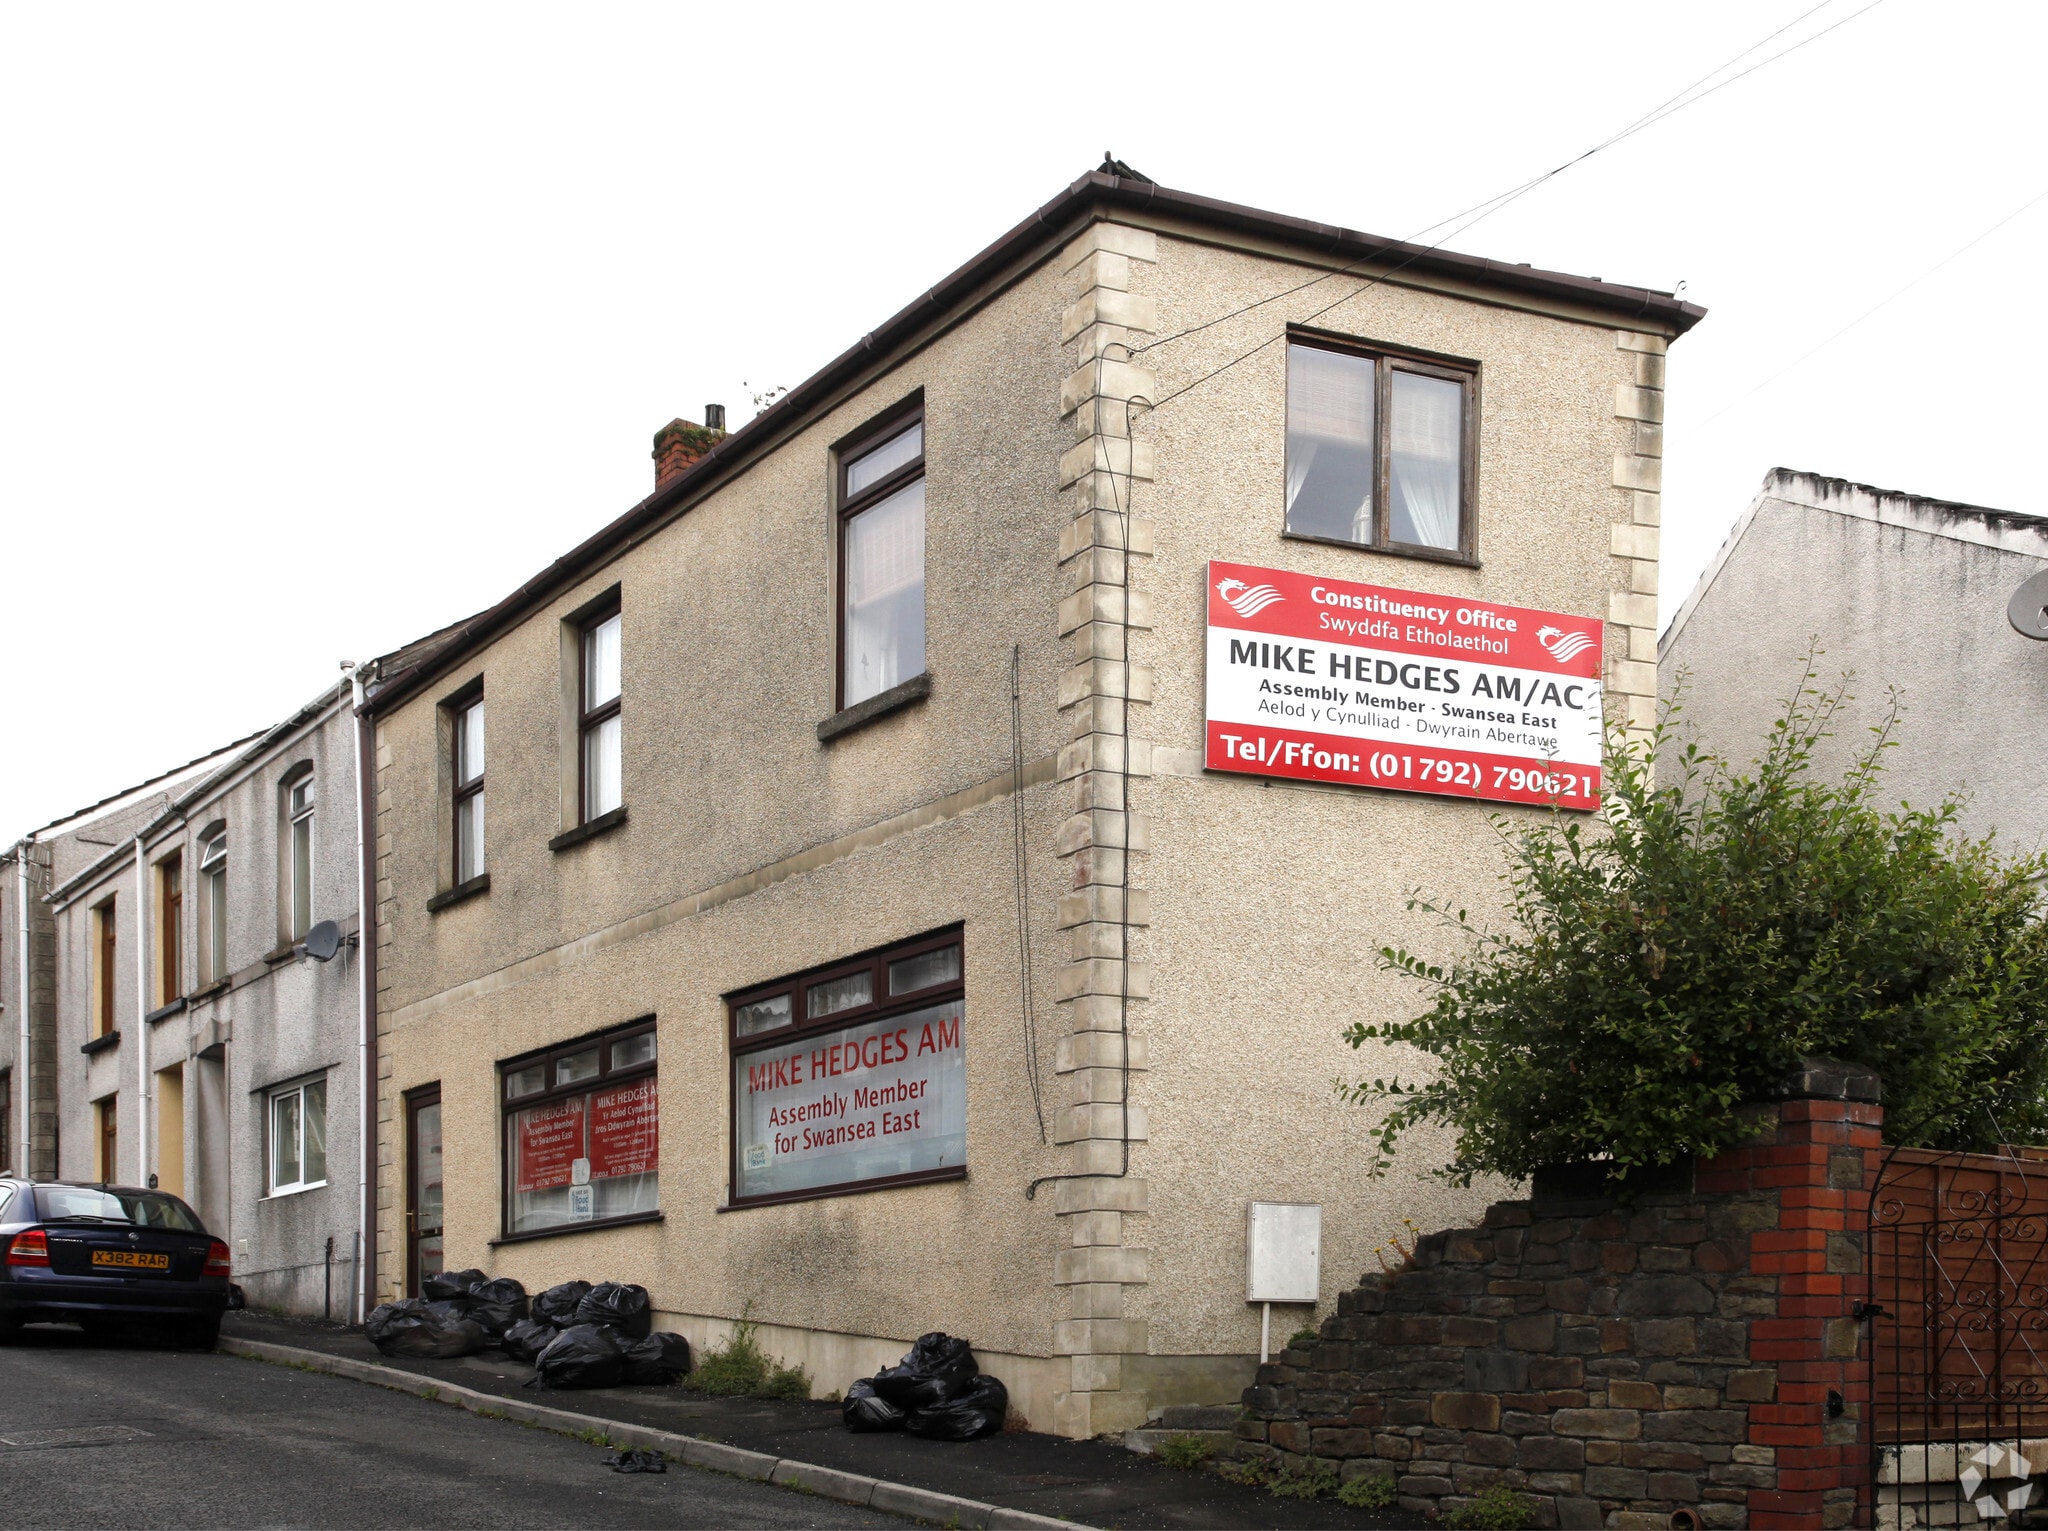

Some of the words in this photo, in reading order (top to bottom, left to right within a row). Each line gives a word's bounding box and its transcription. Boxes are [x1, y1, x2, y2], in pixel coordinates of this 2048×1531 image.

[1310, 586, 1450, 626] Constituency
[1455, 607, 1518, 632] Office
[1318, 612, 1400, 642] Swyddfa
[1405, 625, 1509, 655] Etholaethol
[1229, 638, 1317, 675] MIKE
[1329, 653, 1461, 695] HEDGES
[1471, 673, 1584, 710] AM/AC
[1257, 698, 1306, 718] Aelod
[1311, 708, 1321, 722] y
[1325, 706, 1401, 730] Cynulliad
[1416, 719, 1481, 741] Dwyrain
[1485, 727, 1558, 749] Abertawe
[1258, 679, 1349, 706] Assembly
[1355, 691, 1426, 714] Member
[1441, 702, 1516, 725] Swansea
[1521, 712, 1557, 729] East
[1219, 733, 1360, 773] Tel/Ffon:
[1369, 754, 1482, 790] (01792)
[1492, 766, 1592, 798] 790621
[749, 1054, 803, 1095] MIKE
[811, 1028, 908, 1081] HEDGES
[917, 1016, 960, 1057] AM
[541, 1105, 570, 1121] HEDGES
[570, 1101, 583, 1114] AM
[597, 1094, 616, 1109] MIKE
[617, 1086, 649, 1104] HEDGES
[602, 1111, 609, 1120] Yr
[610, 1107, 627, 1118] Aelod
[768, 1092, 848, 1128] Assembly
[854, 1078, 928, 1111] Member
[529, 1123, 553, 1136] Assembly
[553, 1119, 575, 1130] Member
[539, 1134, 561, 1145] Swansea
[562, 1131, 574, 1140] East
[774, 1132, 798, 1155] for
[802, 1121, 876, 1150] Swansea
[882, 1109, 921, 1135] East
[94, 1251, 136, 1265] X382
[137, 1254, 168, 1267] RAR
